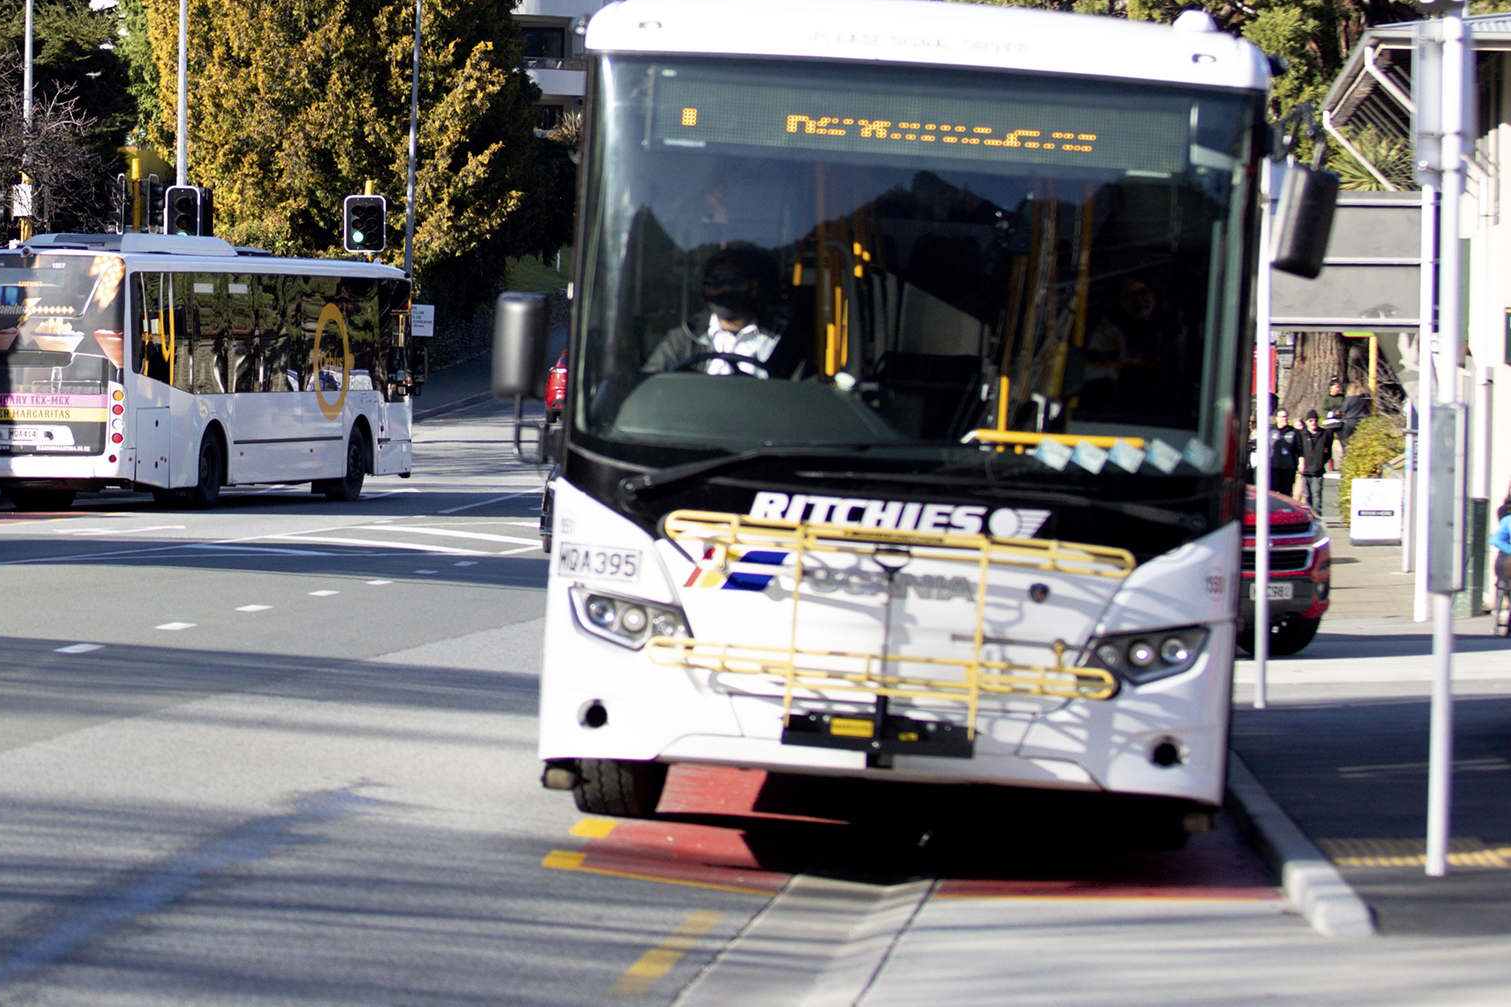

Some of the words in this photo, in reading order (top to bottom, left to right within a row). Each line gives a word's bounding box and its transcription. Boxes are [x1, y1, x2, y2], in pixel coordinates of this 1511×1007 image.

[30, 395, 70, 405] TEX-MEX
[12, 409, 71, 419] MARGARITAS
[748, 492, 988, 535] RITCHIES
